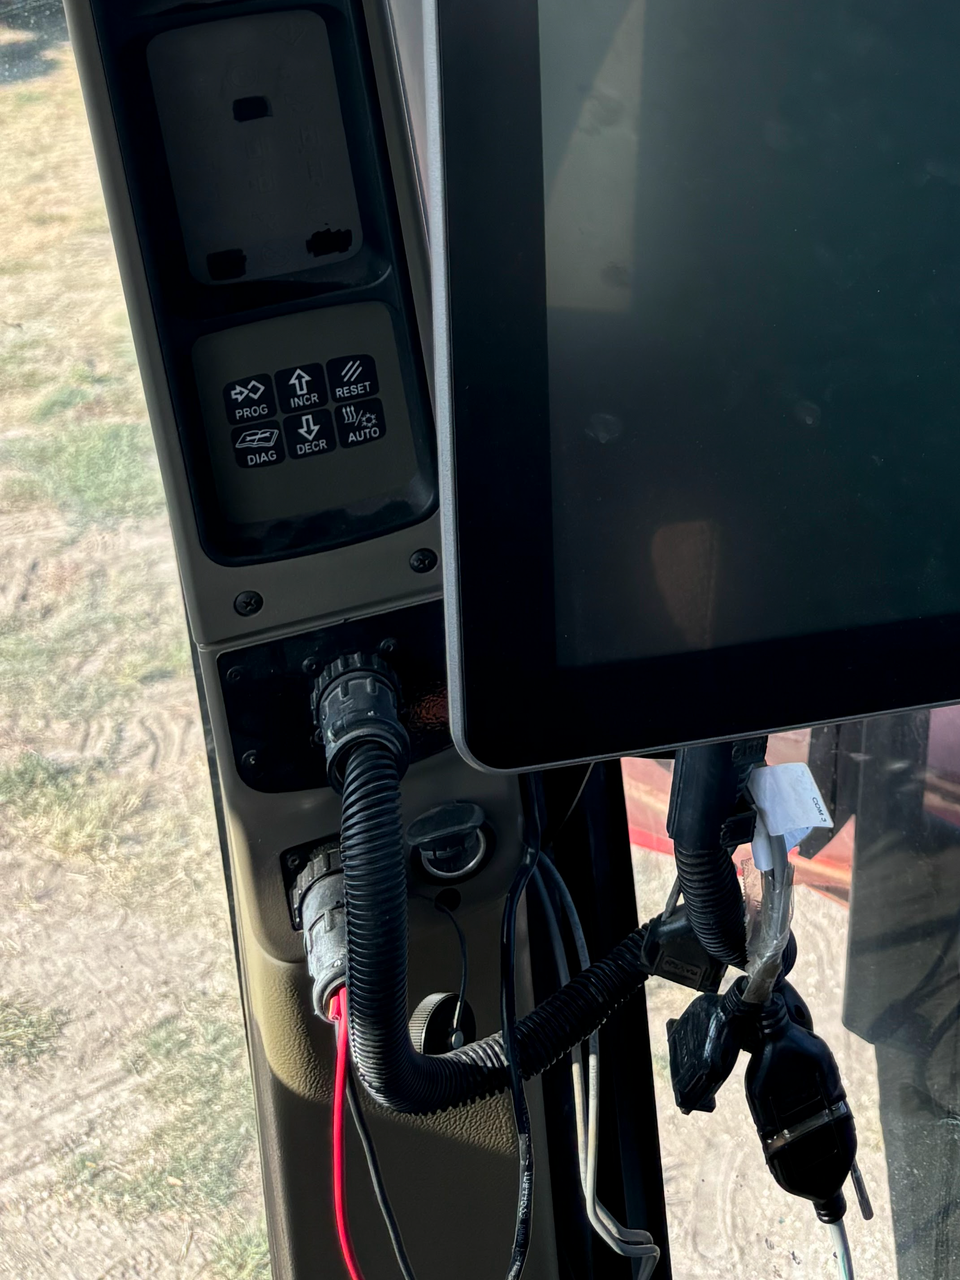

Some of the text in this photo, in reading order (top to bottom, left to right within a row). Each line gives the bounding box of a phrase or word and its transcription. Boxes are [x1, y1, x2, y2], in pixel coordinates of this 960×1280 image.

[335, 381, 371, 399] RESET
[290, 392, 319, 409] INCR
[235, 403, 269, 420] PROG
[348, 426, 380, 444] AUTO
[296, 439, 328, 456] DECR
[247, 450, 277, 466] DIAG
